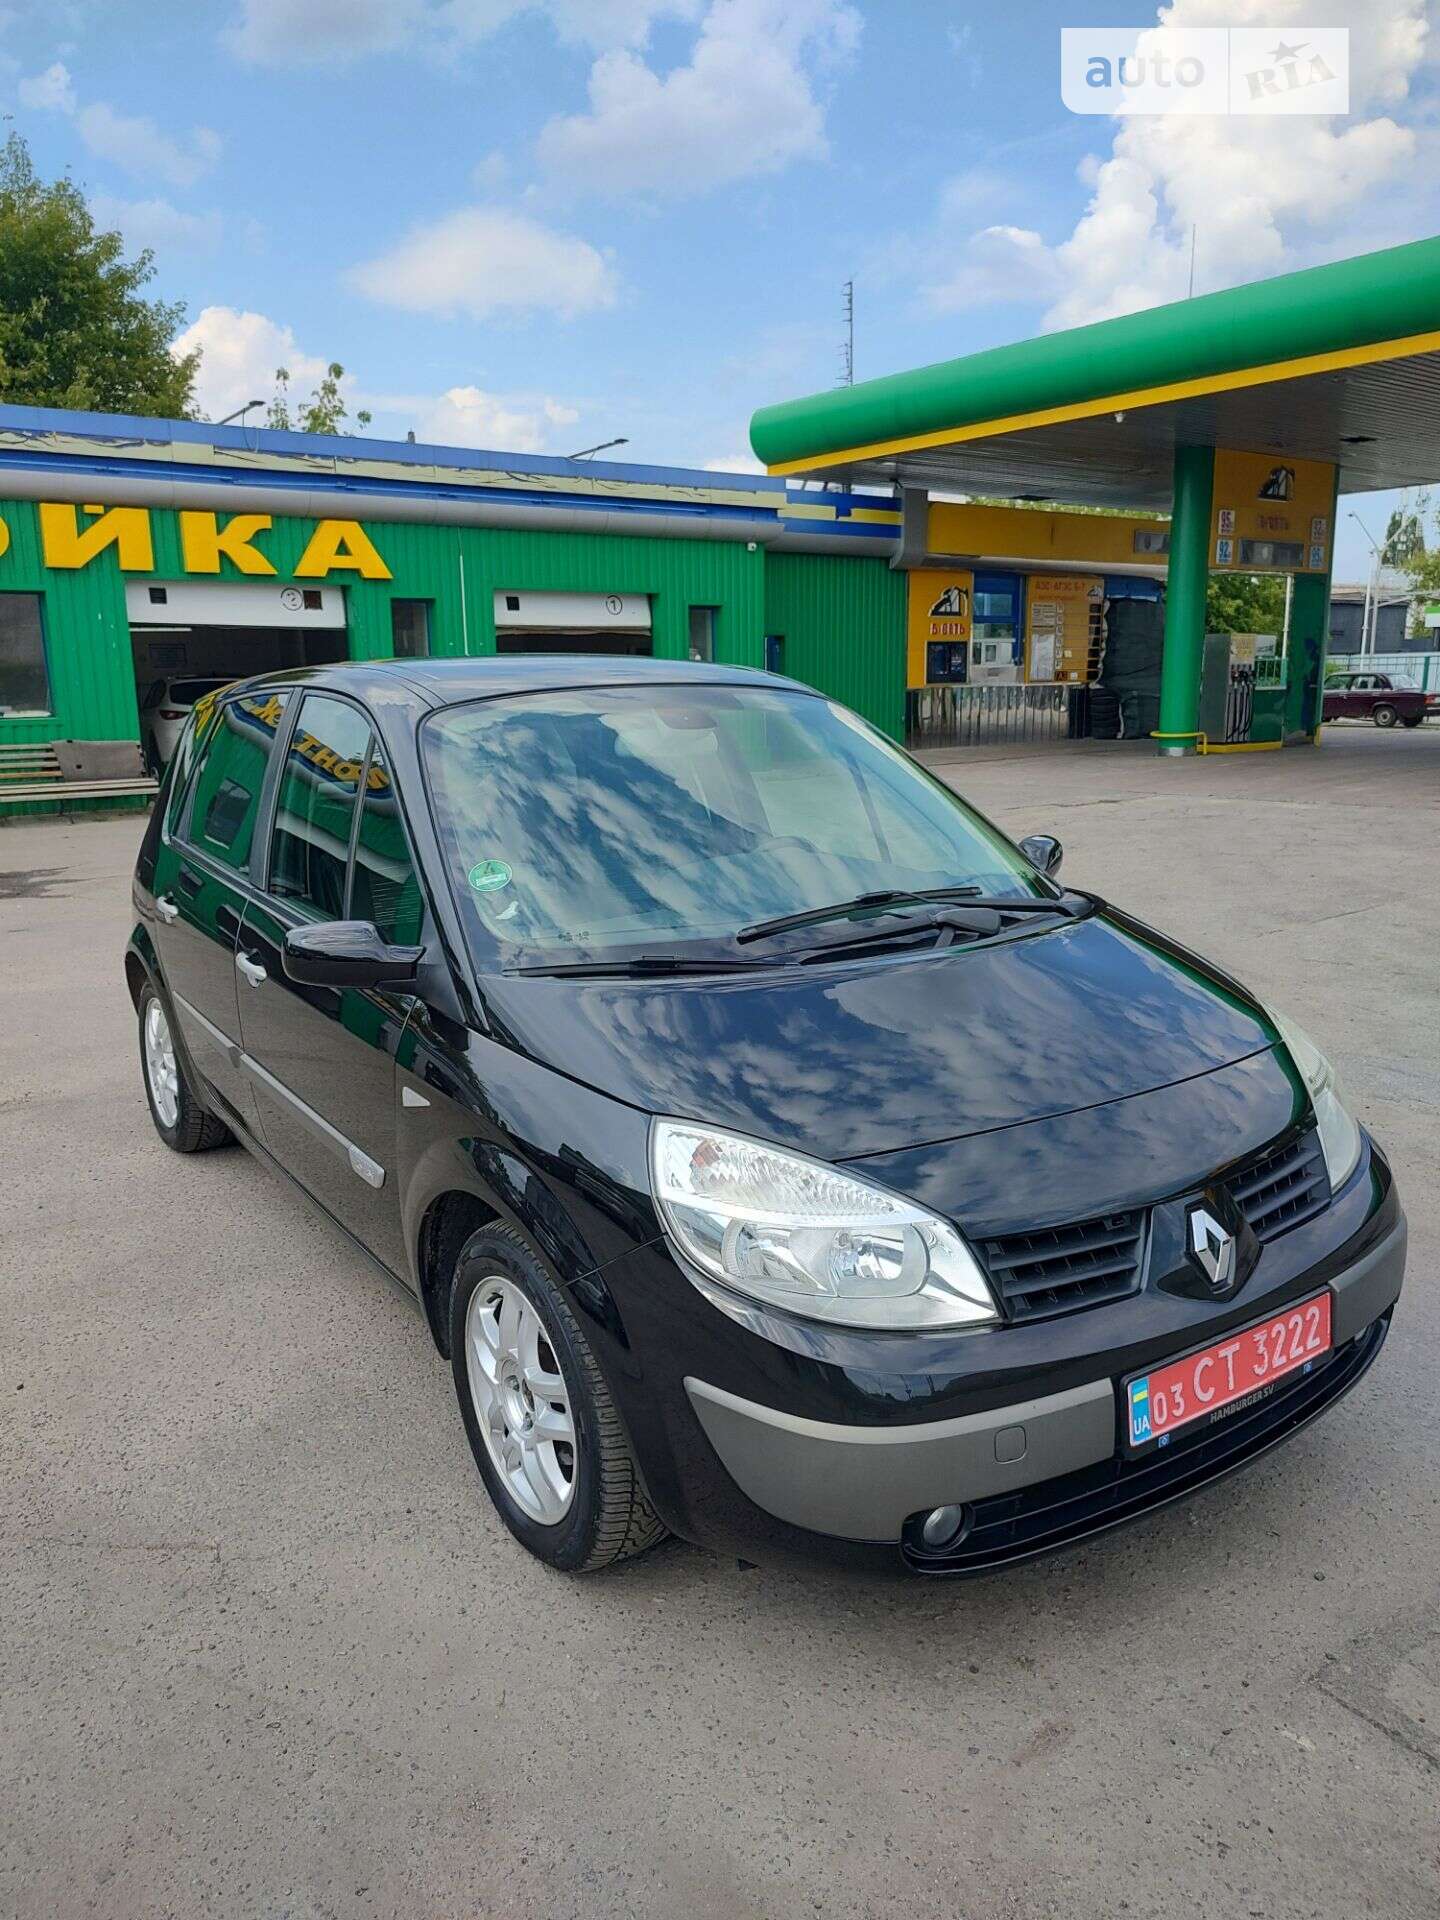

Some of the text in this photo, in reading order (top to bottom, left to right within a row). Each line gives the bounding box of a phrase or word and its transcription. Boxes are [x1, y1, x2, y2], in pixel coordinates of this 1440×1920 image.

[0, 502, 393, 580] ЙКА
[1153, 1306, 1321, 1425] 03 CT 3222
[1133, 1414, 1151, 1436] UA
[1210, 1391, 1262, 1424] HAMBURGER
